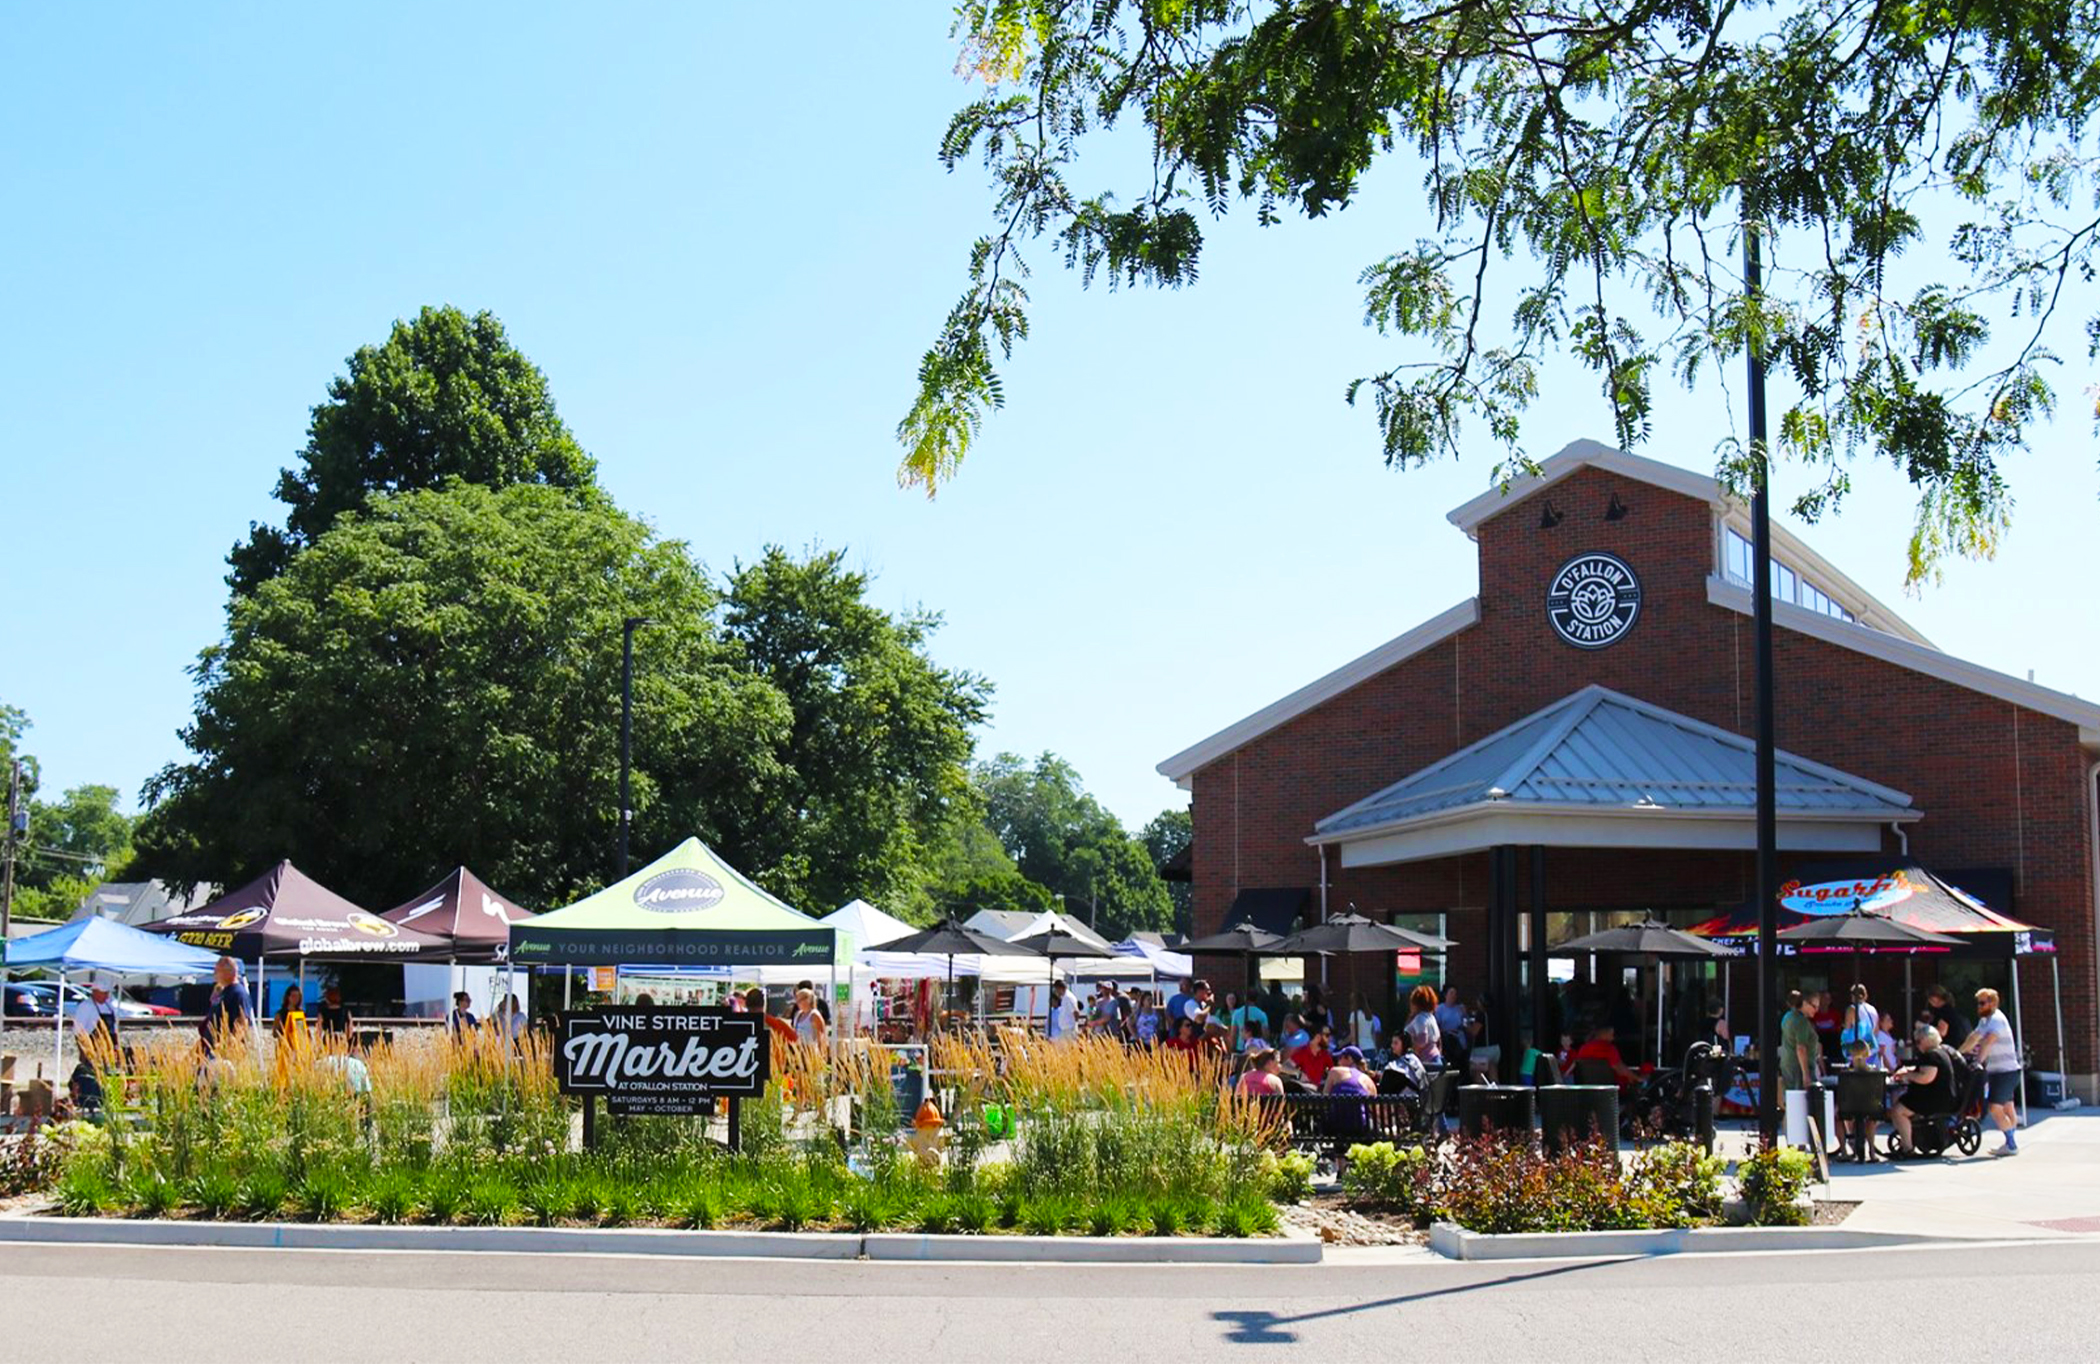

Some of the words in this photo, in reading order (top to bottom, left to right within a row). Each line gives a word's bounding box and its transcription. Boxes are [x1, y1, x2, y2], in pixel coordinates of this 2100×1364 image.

[1561, 562, 1624, 589] O'FALLON
[1566, 614, 1624, 640] STATION
[637, 887, 724, 905] Avenue
[298, 935, 421, 955] globalbrew.com
[513, 939, 551, 955] Avenue
[558, 942, 597, 955] YOUR
[601, 943, 719, 956] NEIGHBORHOOD
[724, 943, 785, 957] REALTOR
[791, 942, 830, 957] Avenue
[602, 1015, 646, 1030] VINE
[652, 1015, 723, 1031] STREET
[563, 1032, 760, 1089] Market
[618, 1081, 629, 1091] AT
[630, 1081, 671, 1091] O'FALLON
[671, 1082, 708, 1091] STATION
[611, 1096, 658, 1104] SATURDAYS
[666, 1097, 680, 1105] AM
[688, 1097, 696, 1105] 12
[698, 1097, 711, 1105] PM
[628, 1104, 646, 1112] MAY
[654, 1105, 694, 1113] OCTOBER
